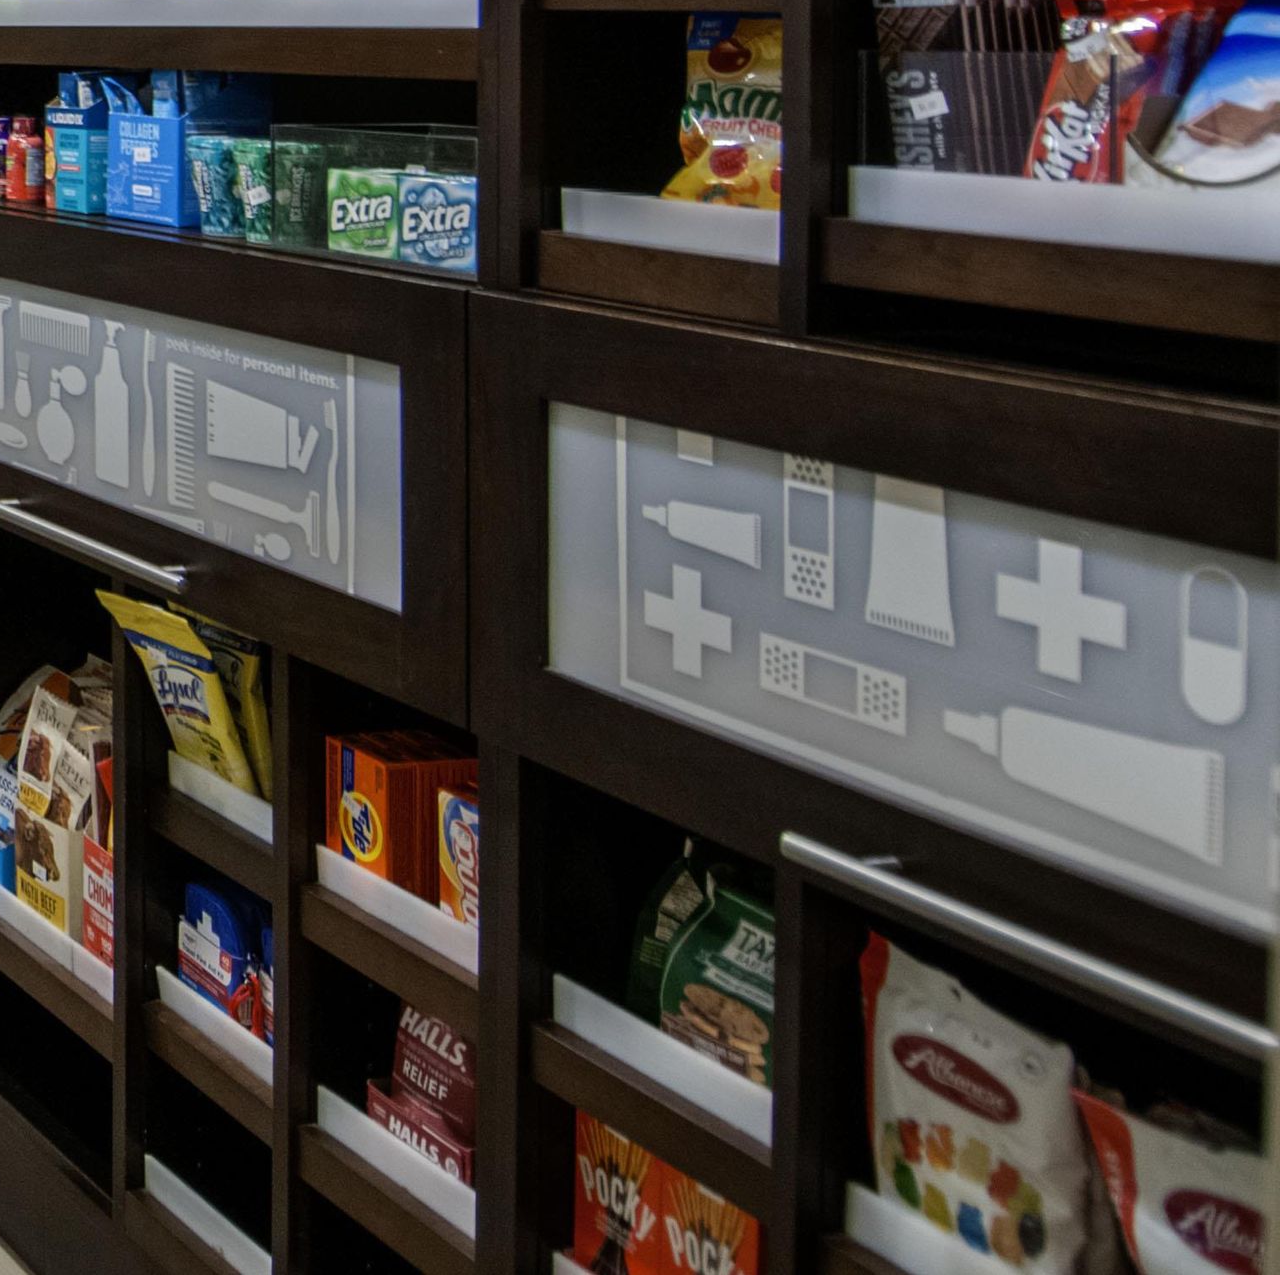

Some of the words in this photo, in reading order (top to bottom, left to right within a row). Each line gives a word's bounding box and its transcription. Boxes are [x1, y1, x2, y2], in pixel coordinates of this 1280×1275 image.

[119, 120, 161, 141] COLLAGEN
[933, 133, 948, 159] milk
[330, 195, 393, 231] Extra
[401, 203, 471, 242] Extra
[165, 337, 190, 353] peek
[191, 340, 223, 362] inside
[224, 348, 241, 364] for
[242, 356, 296, 380] personal
[297, 366, 340, 390] items.
[158, 669, 202, 705] Lysol
[60, 759, 89, 788] EPIC
[40, 891, 57, 916] BEEF
[400, 1005, 468, 1070] HALLS
[402, 1059, 449, 1101] RELIEF
[388, 1114, 440, 1165] HALLS
[578, 1153, 657, 1242] POCKY
[664, 1214, 744, 1275] POCK
